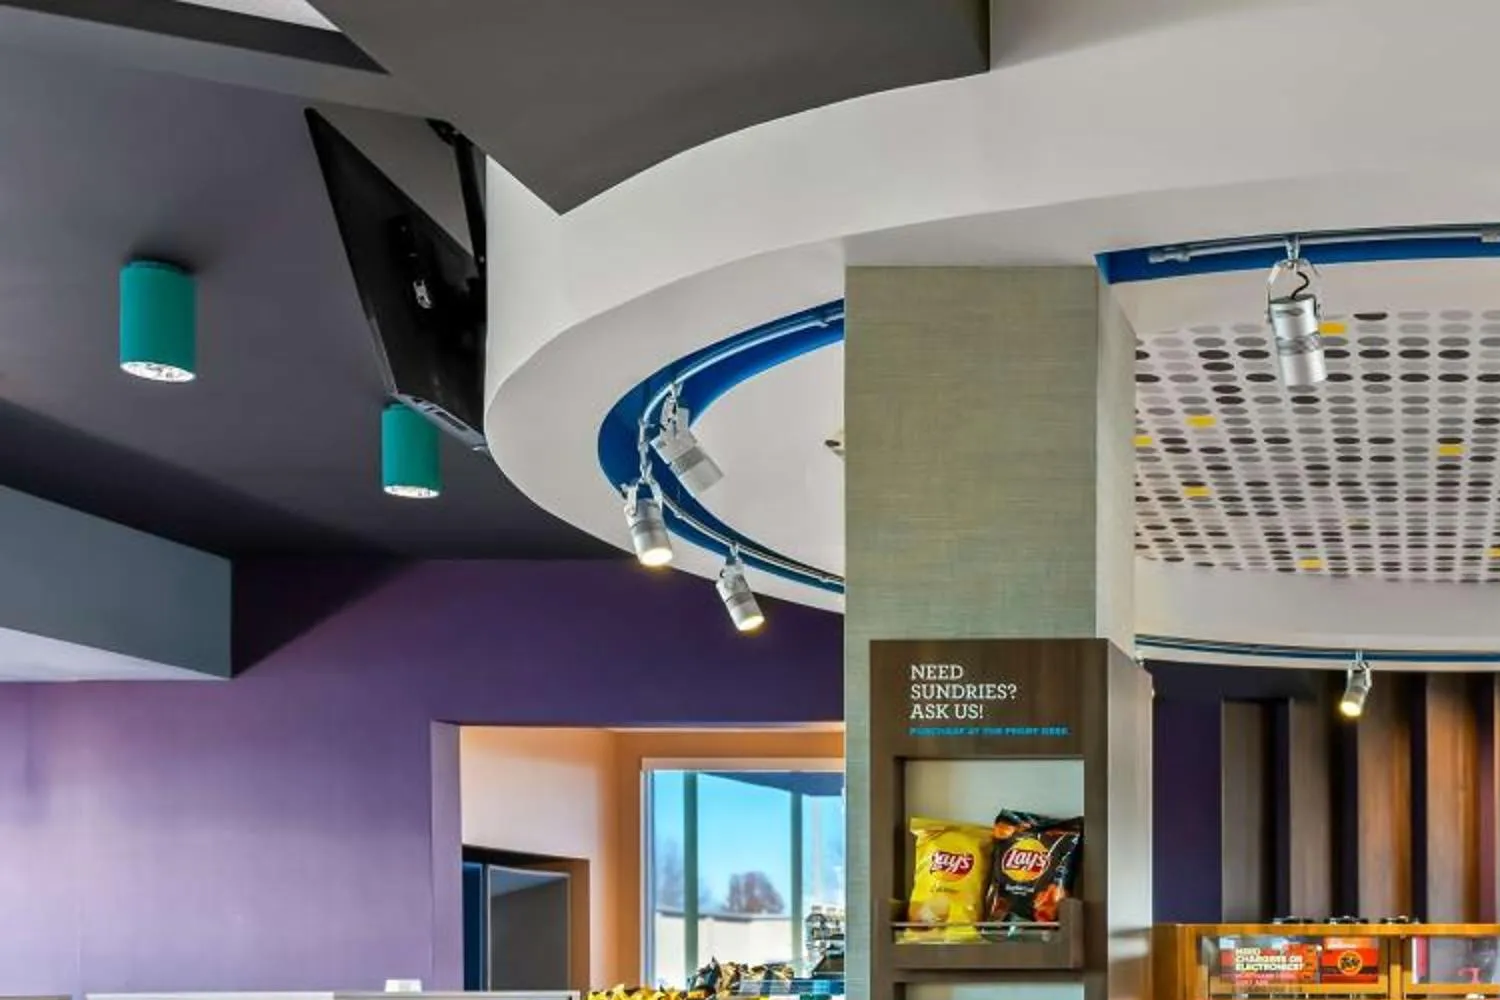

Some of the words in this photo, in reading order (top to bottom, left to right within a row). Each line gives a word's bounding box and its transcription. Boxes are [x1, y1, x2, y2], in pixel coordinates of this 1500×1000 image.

[910, 664, 964, 680] NEED
[910, 683, 1018, 700] SUNDRIES?
[909, 703, 950, 720] ASK
[954, 703, 984, 720] US!
[1006, 850, 1048, 871] Lay's
